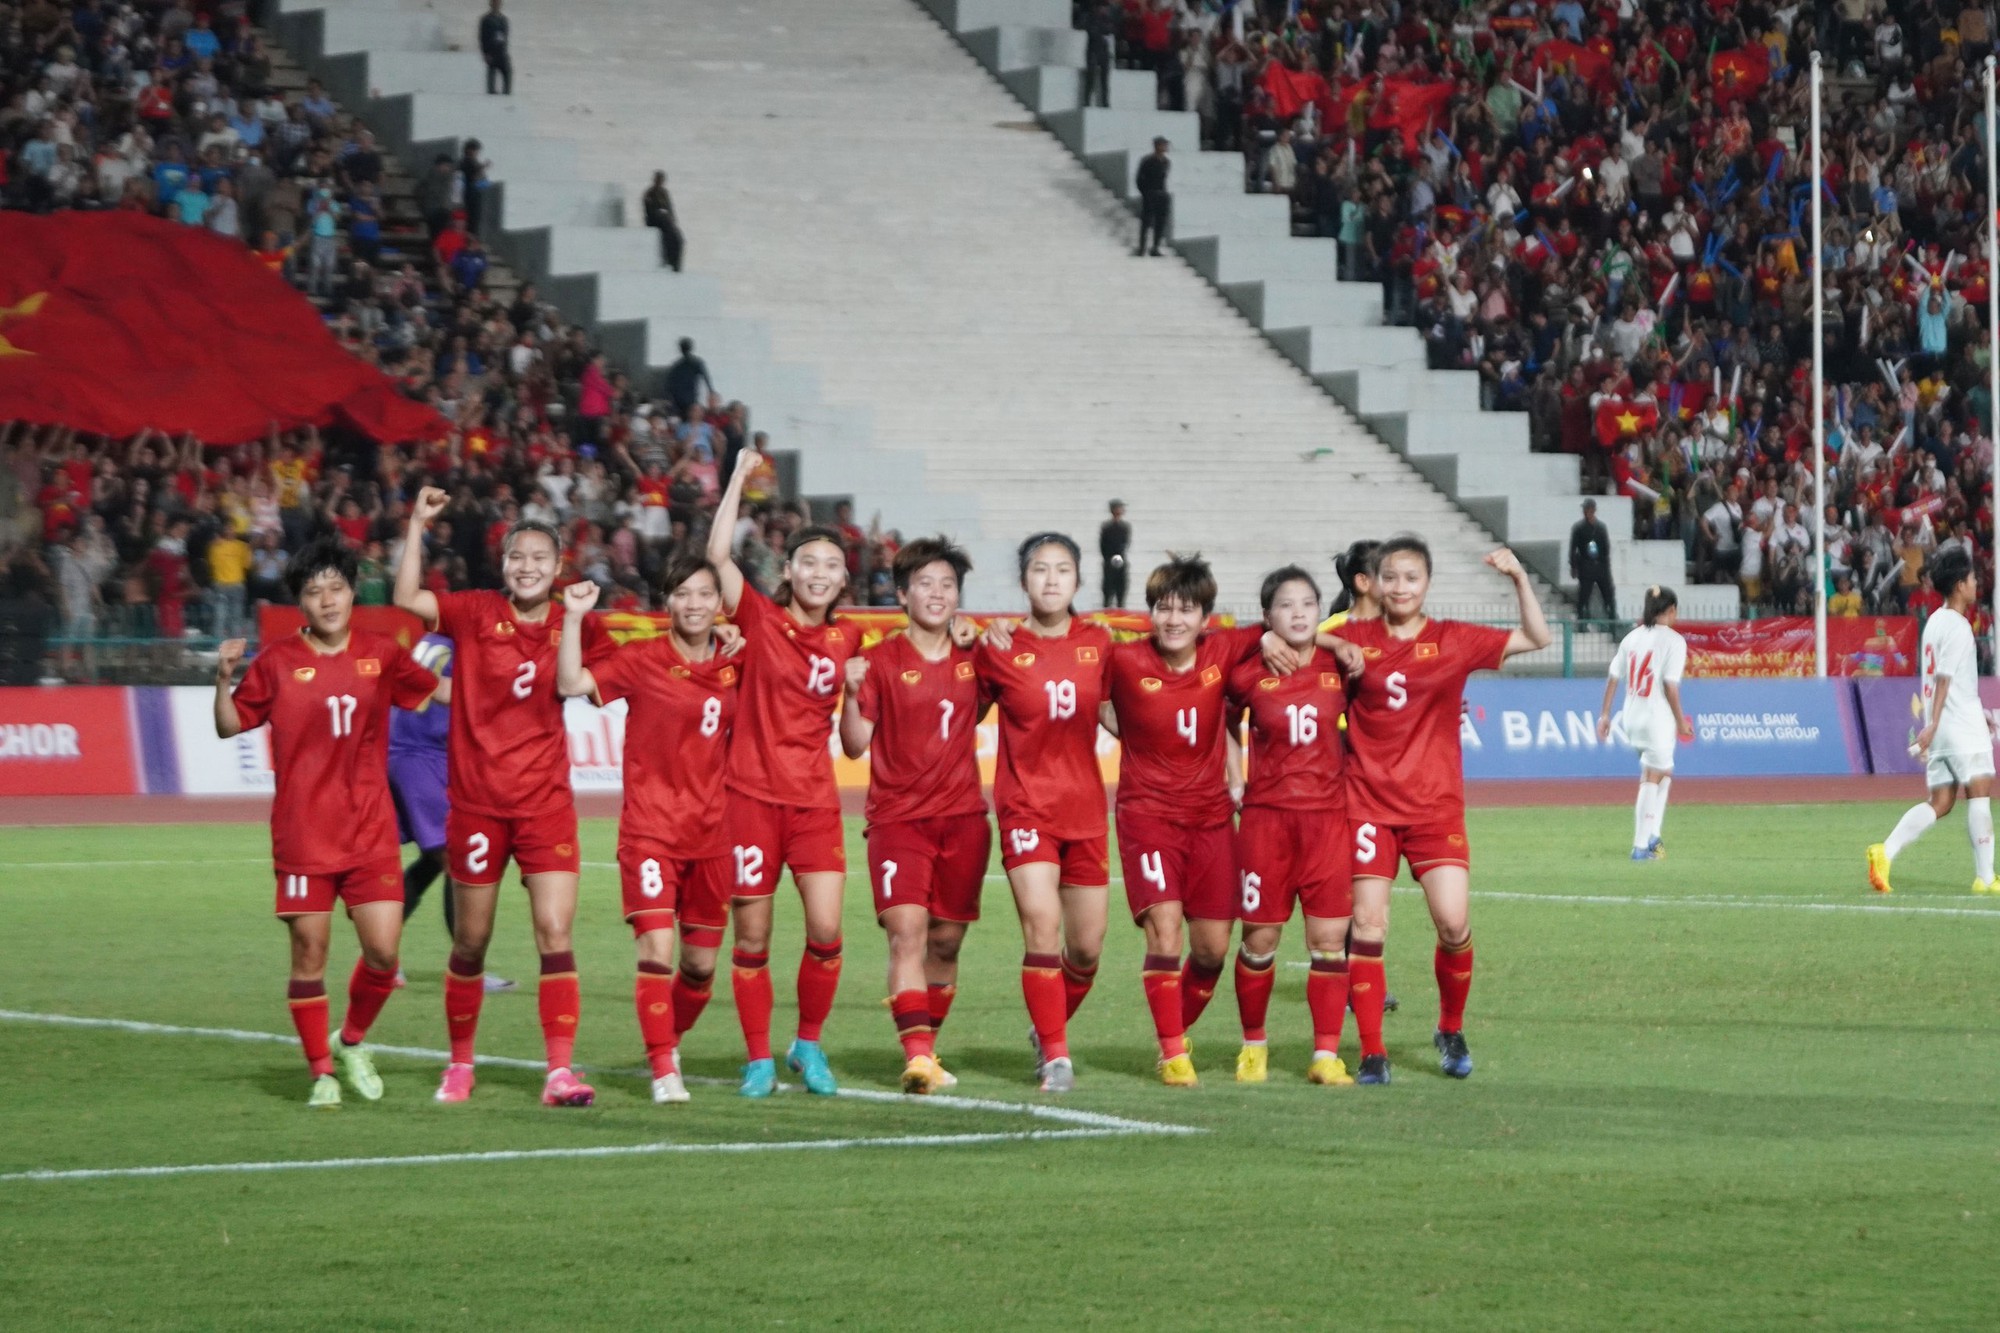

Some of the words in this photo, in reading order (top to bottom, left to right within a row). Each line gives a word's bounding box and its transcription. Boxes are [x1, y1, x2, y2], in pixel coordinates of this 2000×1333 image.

[513, 660, 536, 698] 2
[807, 653, 836, 694] 12
[1627, 649, 1656, 698] 16
[327, 694, 357, 738] 17
[700, 696, 722, 738] 8
[1044, 678, 1077, 720] 19
[1697, 712, 1760, 725] NATIONAL
[1762, 712, 1799, 725] BANK
[1177, 706, 1197, 746] 4
[1286, 703, 1318, 745] 16
[1502, 710, 1632, 745] BANK
[1700, 726, 1717, 739] OF
[1720, 726, 1774, 740] CANADA
[1775, 726, 1820, 739] GROUP
[468, 831, 489, 874] 2
[733, 844, 763, 886] 12
[1139, 849, 1166, 891] 4
[639, 857, 663, 898] 8
[1242, 871, 1261, 912] 6
